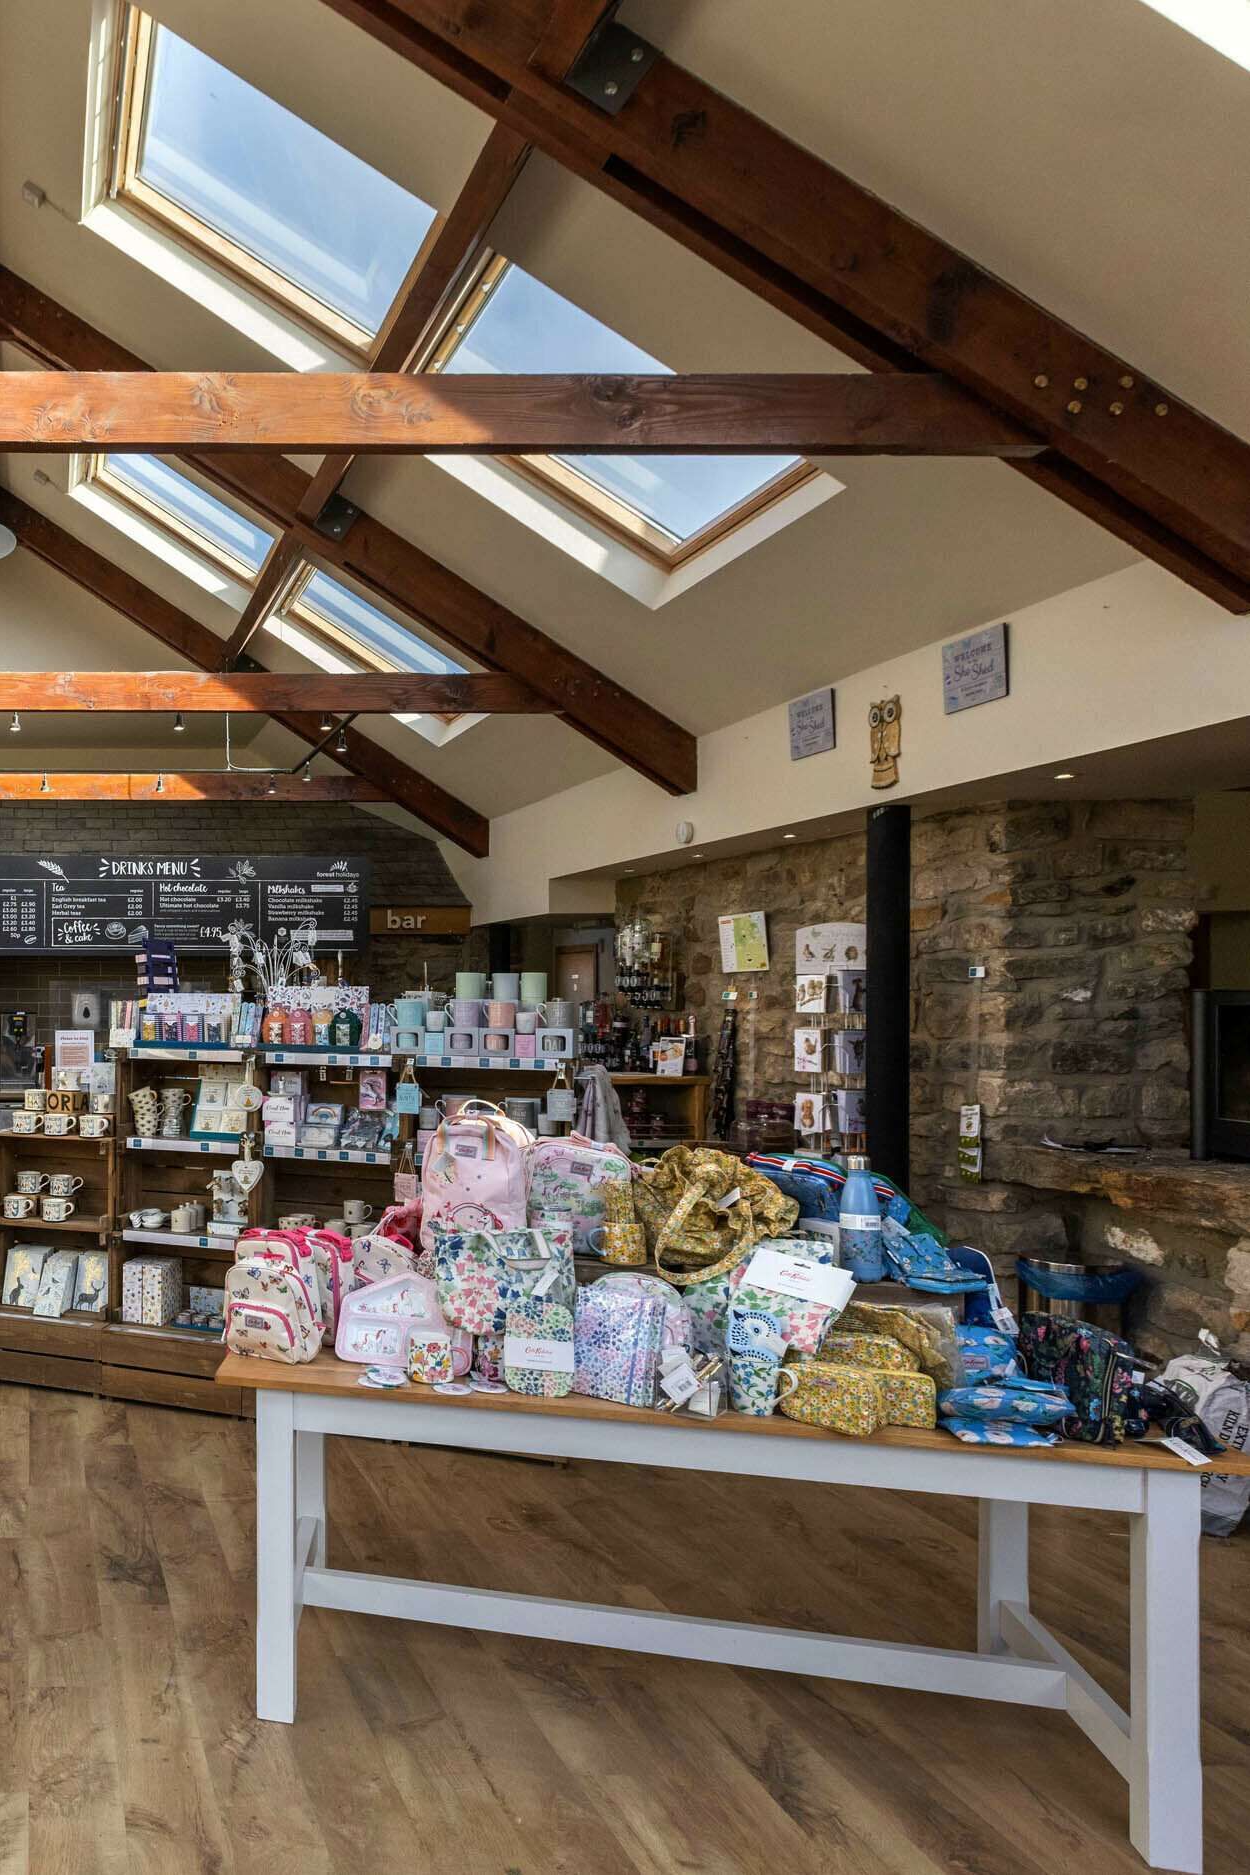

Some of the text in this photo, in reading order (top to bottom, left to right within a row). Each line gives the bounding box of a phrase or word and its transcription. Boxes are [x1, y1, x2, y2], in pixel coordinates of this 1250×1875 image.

[954, 643, 992, 662] WELCOME
[111, 861, 188, 875] DRINKS MENU
[52, 882, 66, 892] Tea
[159, 882, 208, 893] Hot chocolate
[267, 884, 306, 895] Milkshakes
[387, 909, 427, 929] bar
[63, 920, 92, 934] Coffee
[199, 926, 222, 938] £4.95
[65, 932, 94, 944] & cake
[1221, 1409, 1241, 1434] KILN
